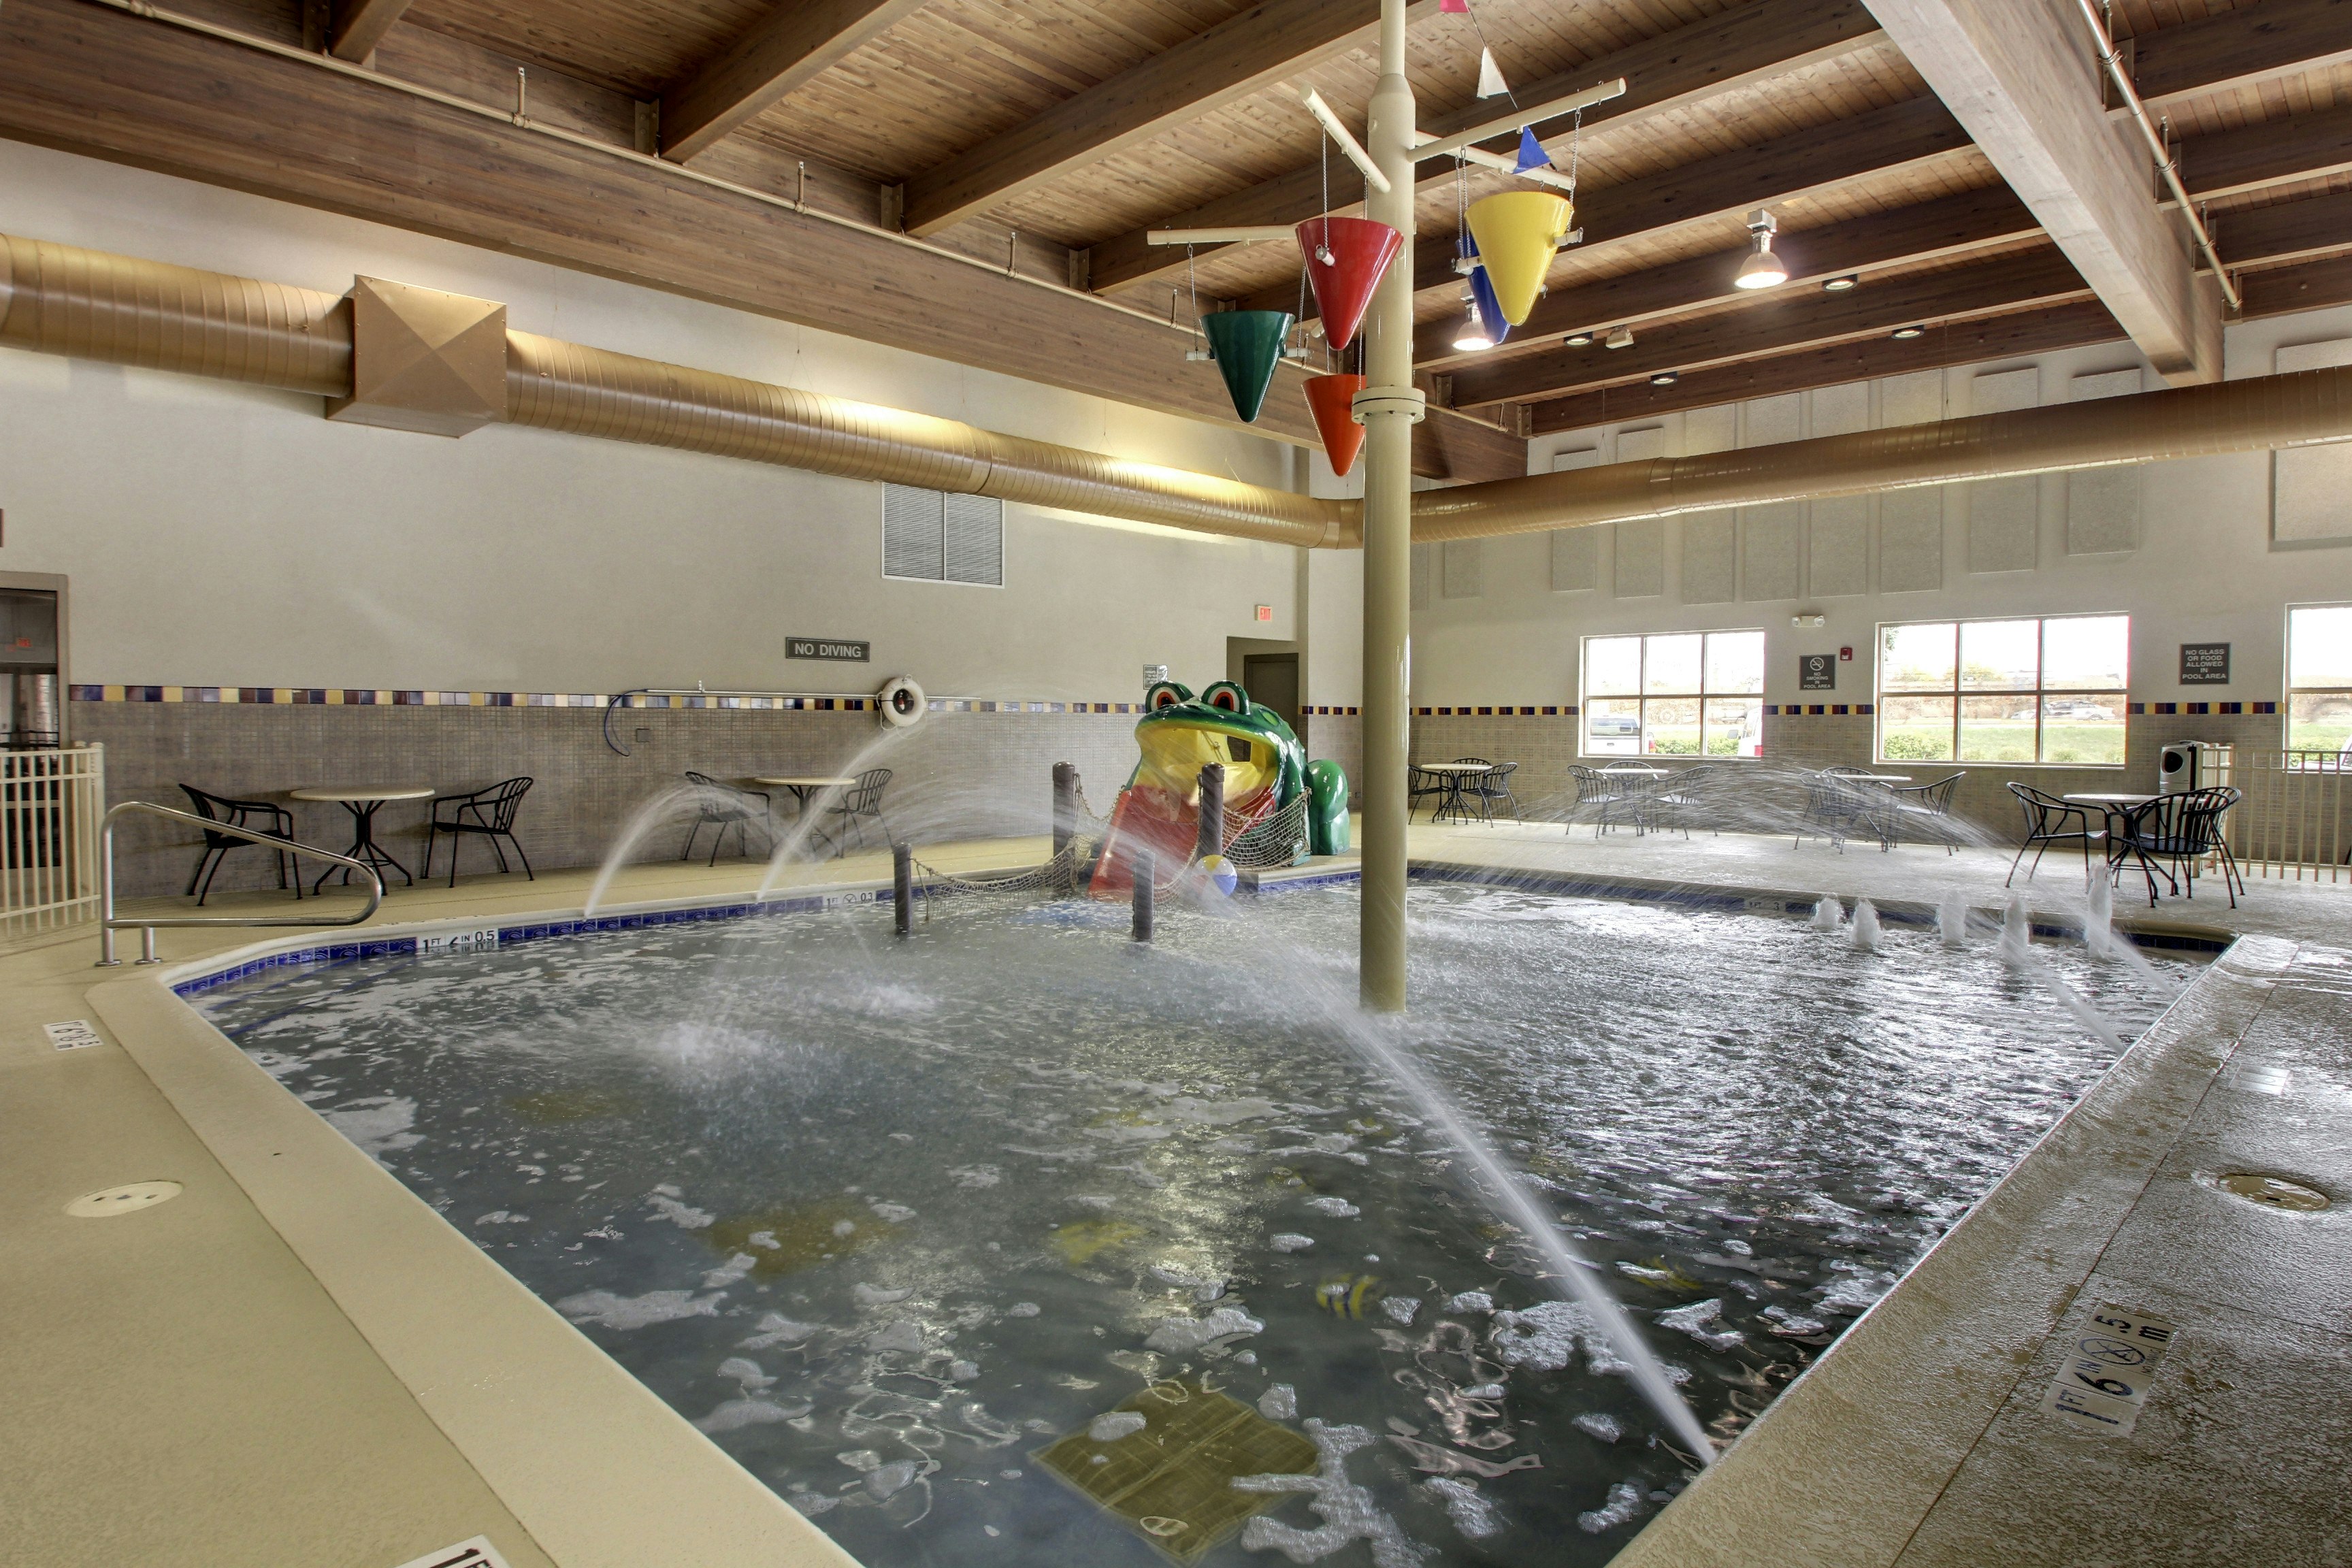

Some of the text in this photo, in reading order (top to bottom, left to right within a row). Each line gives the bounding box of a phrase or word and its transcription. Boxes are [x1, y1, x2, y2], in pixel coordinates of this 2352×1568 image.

[1260, 607, 1271, 620] EXIT
[795, 642, 862, 657] NO DIVING
[475, 930, 495, 942] 0.5
[2138, 1326, 2170, 1342] m
[2141, 1365, 2154, 1375] NO
[2055, 1360, 2134, 1425] 1 FT 6 IN
